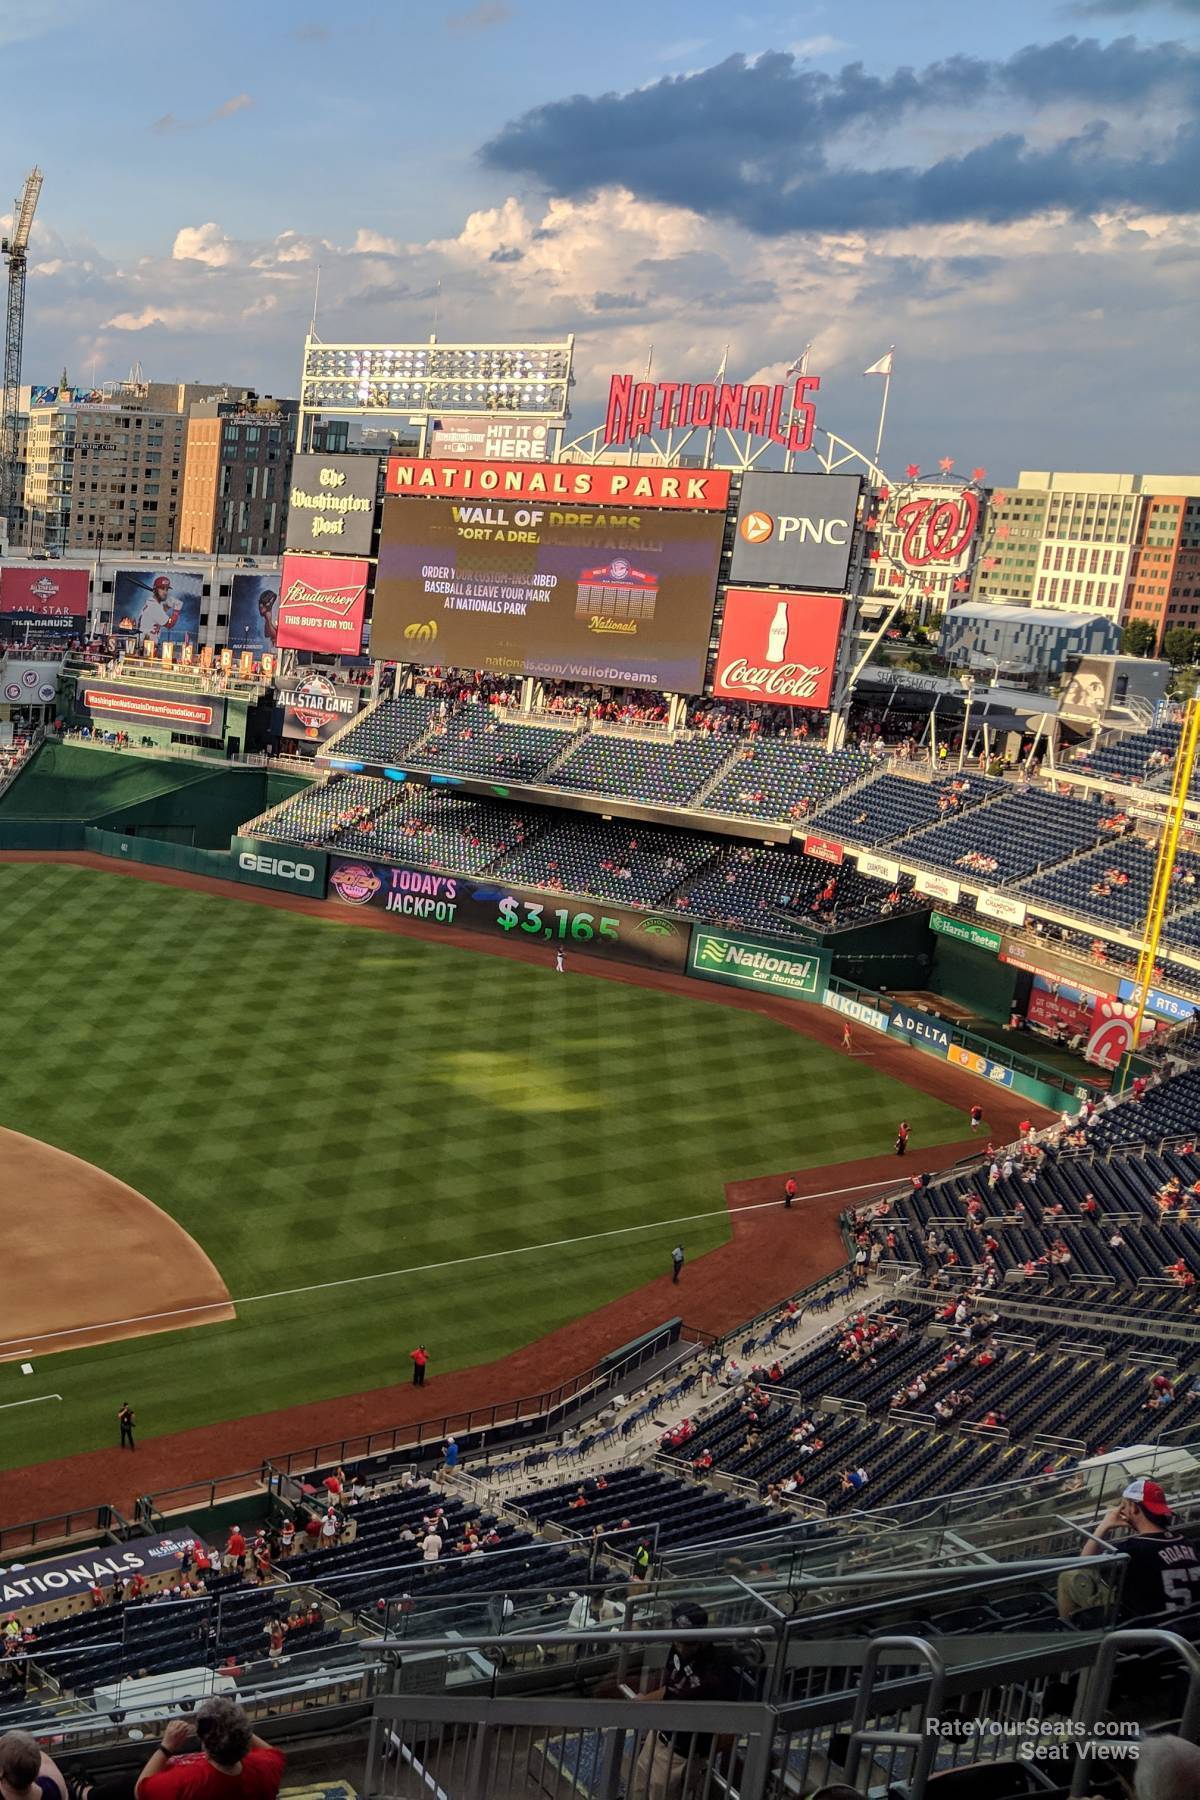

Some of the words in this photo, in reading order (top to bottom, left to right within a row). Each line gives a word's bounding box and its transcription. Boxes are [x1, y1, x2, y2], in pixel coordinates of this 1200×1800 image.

[604, 374, 820, 452] NATIONALS
[487, 424, 513, 438] HIT
[516, 425, 531, 439] IT
[485, 439, 546, 458] HERE
[320, 468, 346, 488] The
[396, 466, 593, 495] NATIONALS
[610, 475, 710, 500] PARK
[290, 487, 372, 514] Washington
[311, 516, 345, 538] Post
[451, 506, 510, 526] WALL
[514, 510, 544, 528] OF
[549, 512, 641, 530] DREAMS
[777, 515, 849, 545] PNC
[421, 565, 449, 579] ORDER
[287, 584, 354, 606] Budweiser
[424, 580, 464, 596] BASEBALL
[465, 583, 472, 596] &
[473, 584, 499, 598] LEAVE
[500, 586, 524, 600] YOUR
[525, 589, 551, 602] MARK
[42, 606, 70, 615] STAR
[443, 597, 455, 609] AT
[456, 598, 502, 614] NATIONALS
[503, 602, 528, 616] PARK
[285, 615, 300, 625] THIS
[301, 617, 322, 627] BUD'S
[323, 619, 337, 629] FOR
[338, 620, 355, 631] YOU.
[588, 615, 638, 633] Nationals
[485, 655, 658, 684] nationals.com/WallofDreams
[720, 658, 828, 698] Coca-Cola
[907, 676, 939, 692] SHACK
[278, 691, 296, 706] ALL
[297, 694, 323, 709] STAR
[325, 697, 354, 713] GAME
[239, 852, 315, 882] GEICO
[391, 868, 457, 900] TODAY'S
[385, 891, 457, 923] JACKPOT
[496, 895, 620, 942] $3,165
[942, 920, 970, 939] Harris
[970, 931, 998, 950] Teeter
[725, 946, 811, 977] National
[752, 969, 769, 979] Car
[771, 972, 805, 987] Rental
[839, 1001, 884, 1030] KOCH
[906, 1017, 948, 1046] DELTA
